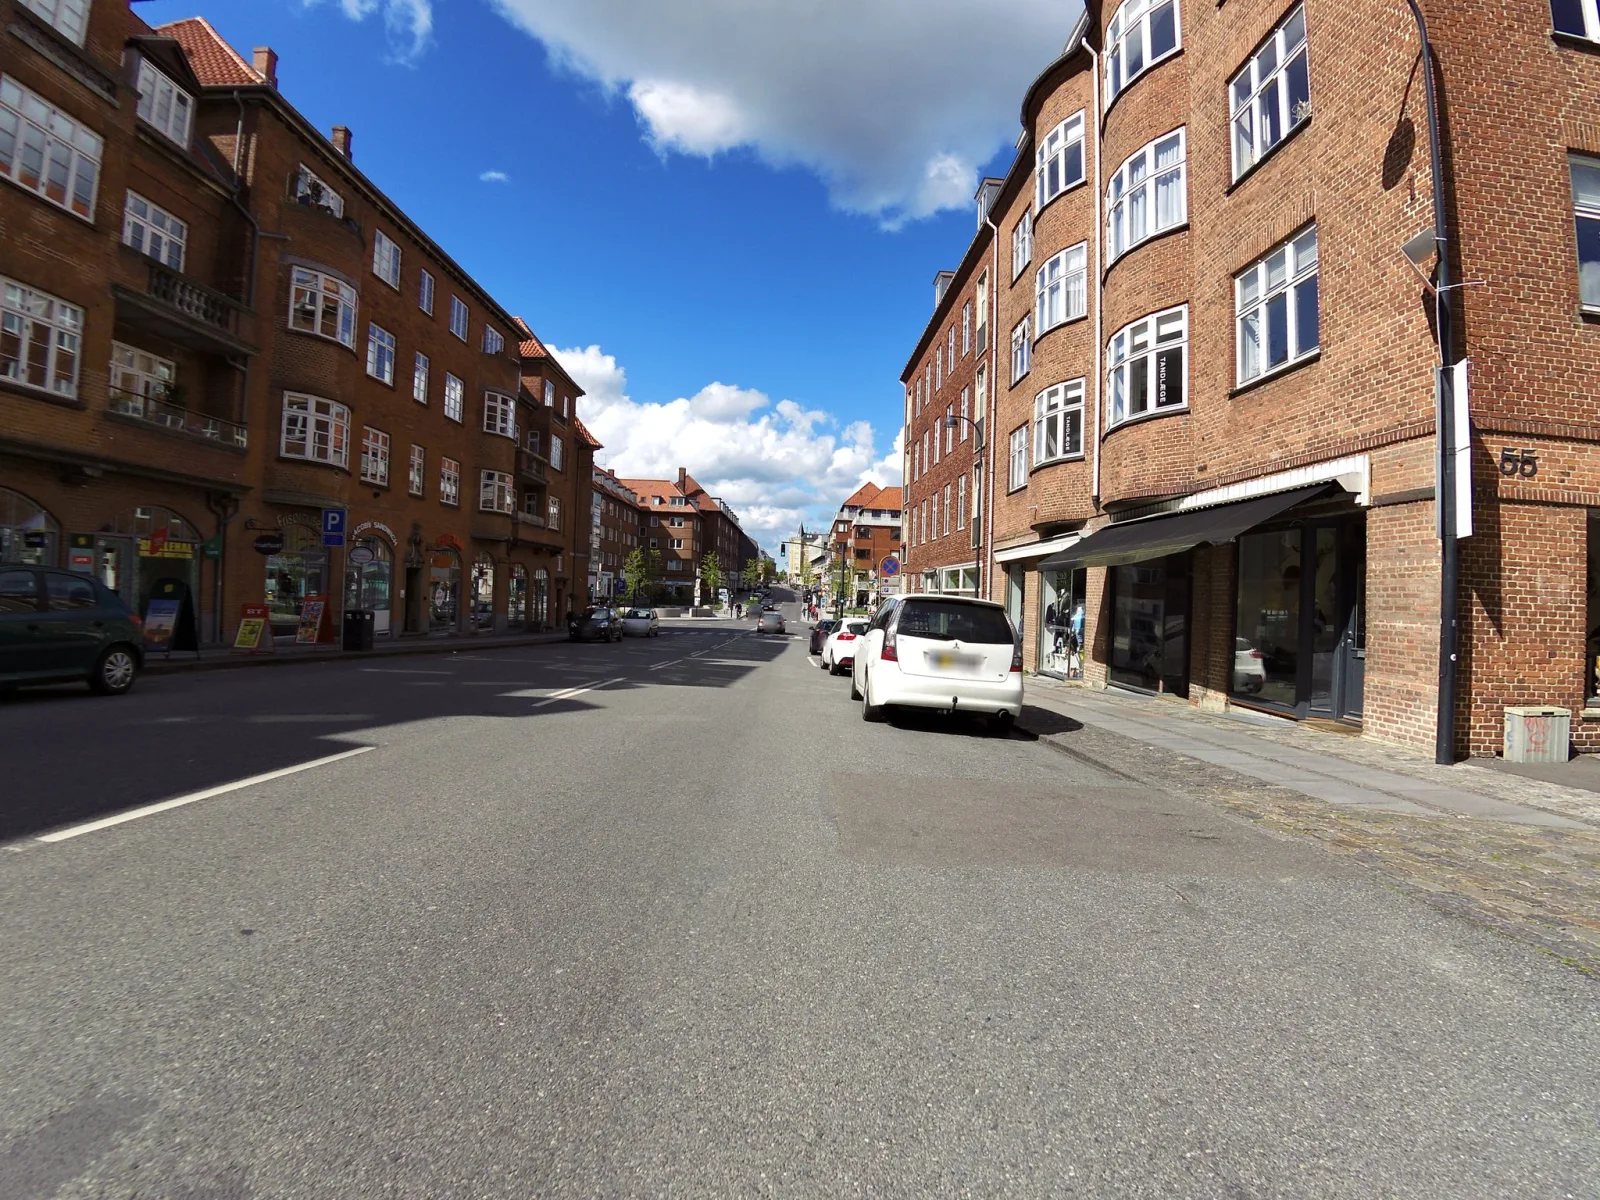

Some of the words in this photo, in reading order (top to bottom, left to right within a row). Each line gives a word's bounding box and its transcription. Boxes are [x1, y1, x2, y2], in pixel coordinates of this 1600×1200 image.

[1159, 356, 1167, 403] TANDLÆGE
[1500, 447, 1539, 477] 55
[327, 512, 340, 530] P
